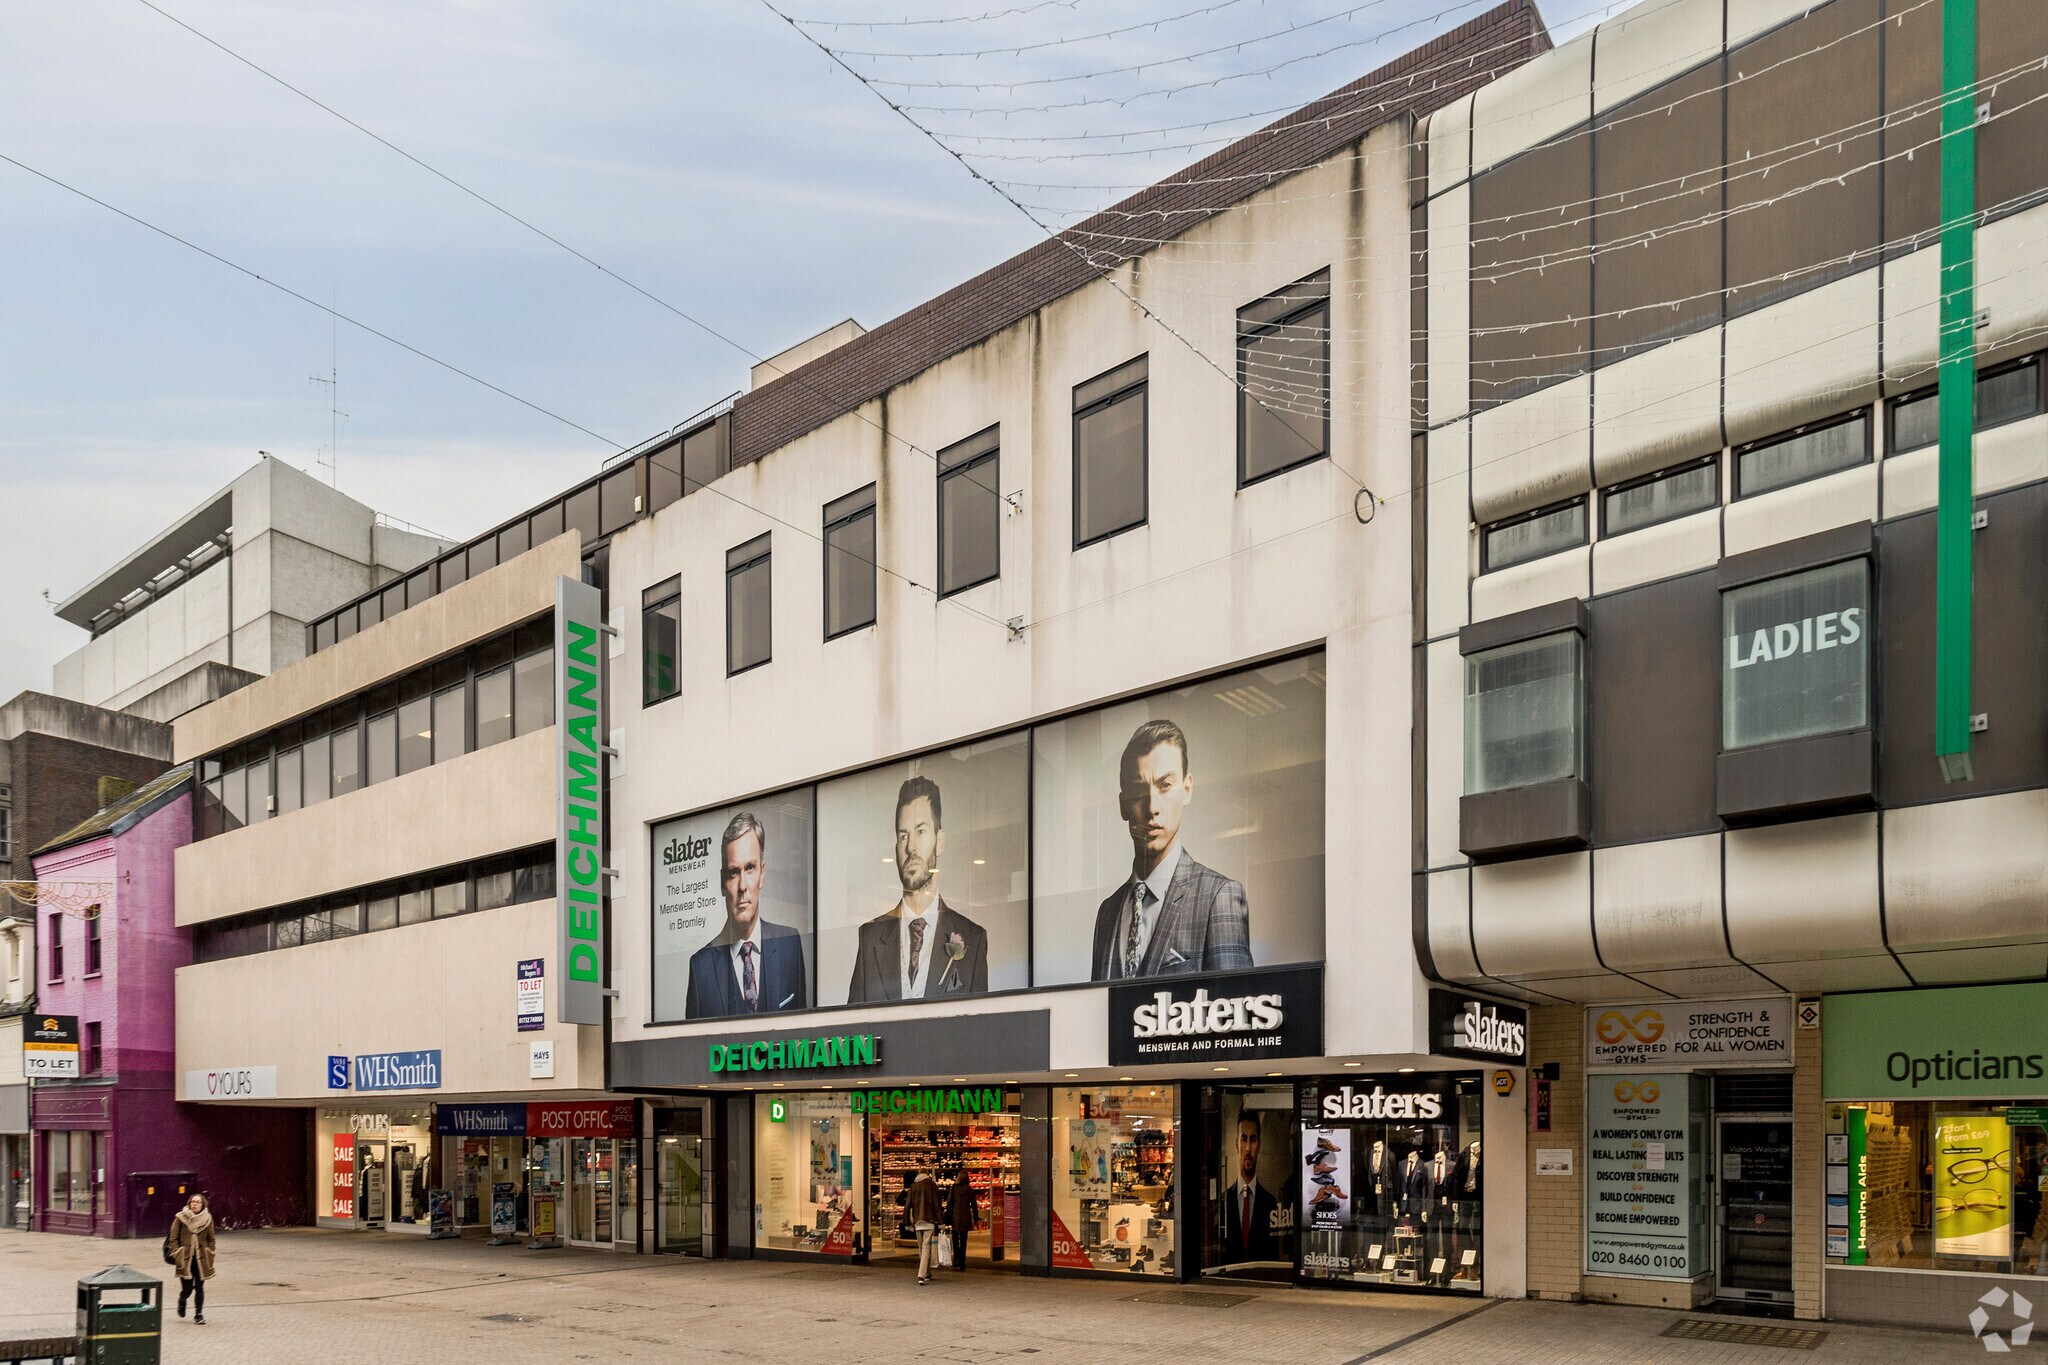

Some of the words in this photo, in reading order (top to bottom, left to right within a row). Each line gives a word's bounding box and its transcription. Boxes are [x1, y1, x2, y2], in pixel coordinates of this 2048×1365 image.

[1730, 608, 1861, 669] LADIES
[568, 620, 599, 983] DEICHMANN
[663, 835, 712, 866] slater
[669, 860, 706, 875] MENSWEAR
[667, 885, 680, 896] The
[682, 878, 709, 894] Largest
[660, 900, 696, 915] Menswear
[697, 896, 716, 909] Store
[669, 920, 676, 931] in
[677, 915, 707, 930] Bromley
[520, 980, 529, 991] TO
[530, 979, 542, 990] LET
[1133, 988, 1284, 1038] slaters
[1688, 1012, 1753, 1026] STRENGTH
[1760, 1010, 1770, 1023] &
[1464, 1002, 1525, 1056] slaters
[1688, 1025, 1770, 1040] CONFIDENCE
[1138, 1038, 1190, 1053] MENSWEAR
[1192, 1039, 1212, 1050] AND
[1214, 1037, 1255, 1049] FORMAL
[1257, 1036, 1282, 1047] HIRE
[1595, 1043, 1667, 1055] EMPOWERED
[1675, 1041, 1699, 1054] FOR
[1704, 1040, 1724, 1052] ALL
[1729, 1039, 1785, 1051] WOMEN
[332, 1057, 346, 1065] WH
[533, 1051, 550, 1060] HAYS
[709, 1034, 876, 1074] DEICHMANN
[1614, 1054, 1647, 1064] GYMS
[28, 1059, 47, 1068] TO
[51, 1060, 73, 1069] LET
[357, 1053, 438, 1088] WHSmith
[1887, 1049, 2044, 1089] Opticians
[217, 1070, 252, 1095] YOURS
[332, 1065, 347, 1087] S
[851, 1088, 1002, 1114] DEICHMANN
[1323, 1086, 1442, 1120] slaters
[611, 1114, 634, 1122] OFFICE
[615, 1106, 632, 1114] POST
[773, 1103, 784, 1119] D
[358, 1114, 389, 1134] YOURS
[453, 1110, 508, 1131] WHSmith
[541, 1110, 571, 1129] POST
[1593, 1130, 1599, 1139] A
[1600, 1129, 1638, 1139] WOMEN'S
[1640, 1130, 1662, 1139] ONLY
[1663, 1130, 1684, 1140] GYM
[1944, 1132, 1969, 1143] from
[1971, 1129, 1990, 1140] £69
[334, 1147, 353, 1161] SALE
[1592, 1150, 1614, 1161] REAL,
[1728, 1145, 1753, 1154] Visitors
[1596, 1171, 1636, 1182] DISCOVER
[1637, 1172, 1679, 1183] STRENGTH
[1858, 1155, 1867, 1187] Aids
[334, 1173, 353, 1187] SALE
[1600, 1192, 1622, 1202] BUILD
[1623, 1192, 1675, 1204] CONFIDENCE
[333, 1199, 353, 1214] SALE
[1316, 1211, 1338, 1219] SHOES
[1596, 1212, 1628, 1223] BECOME
[1629, 1214, 1680, 1226] EMPOWERED
[1858, 1191, 1867, 1249] Hearing
[1593, 1239, 1686, 1250] www.empoweredgyms.co.uk
[1303, 1252, 1350, 1268] slaters
[1592, 1251, 1615, 1264] 020
[1619, 1253, 1650, 1266] 8460
[1654, 1255, 1686, 1268] 0100
